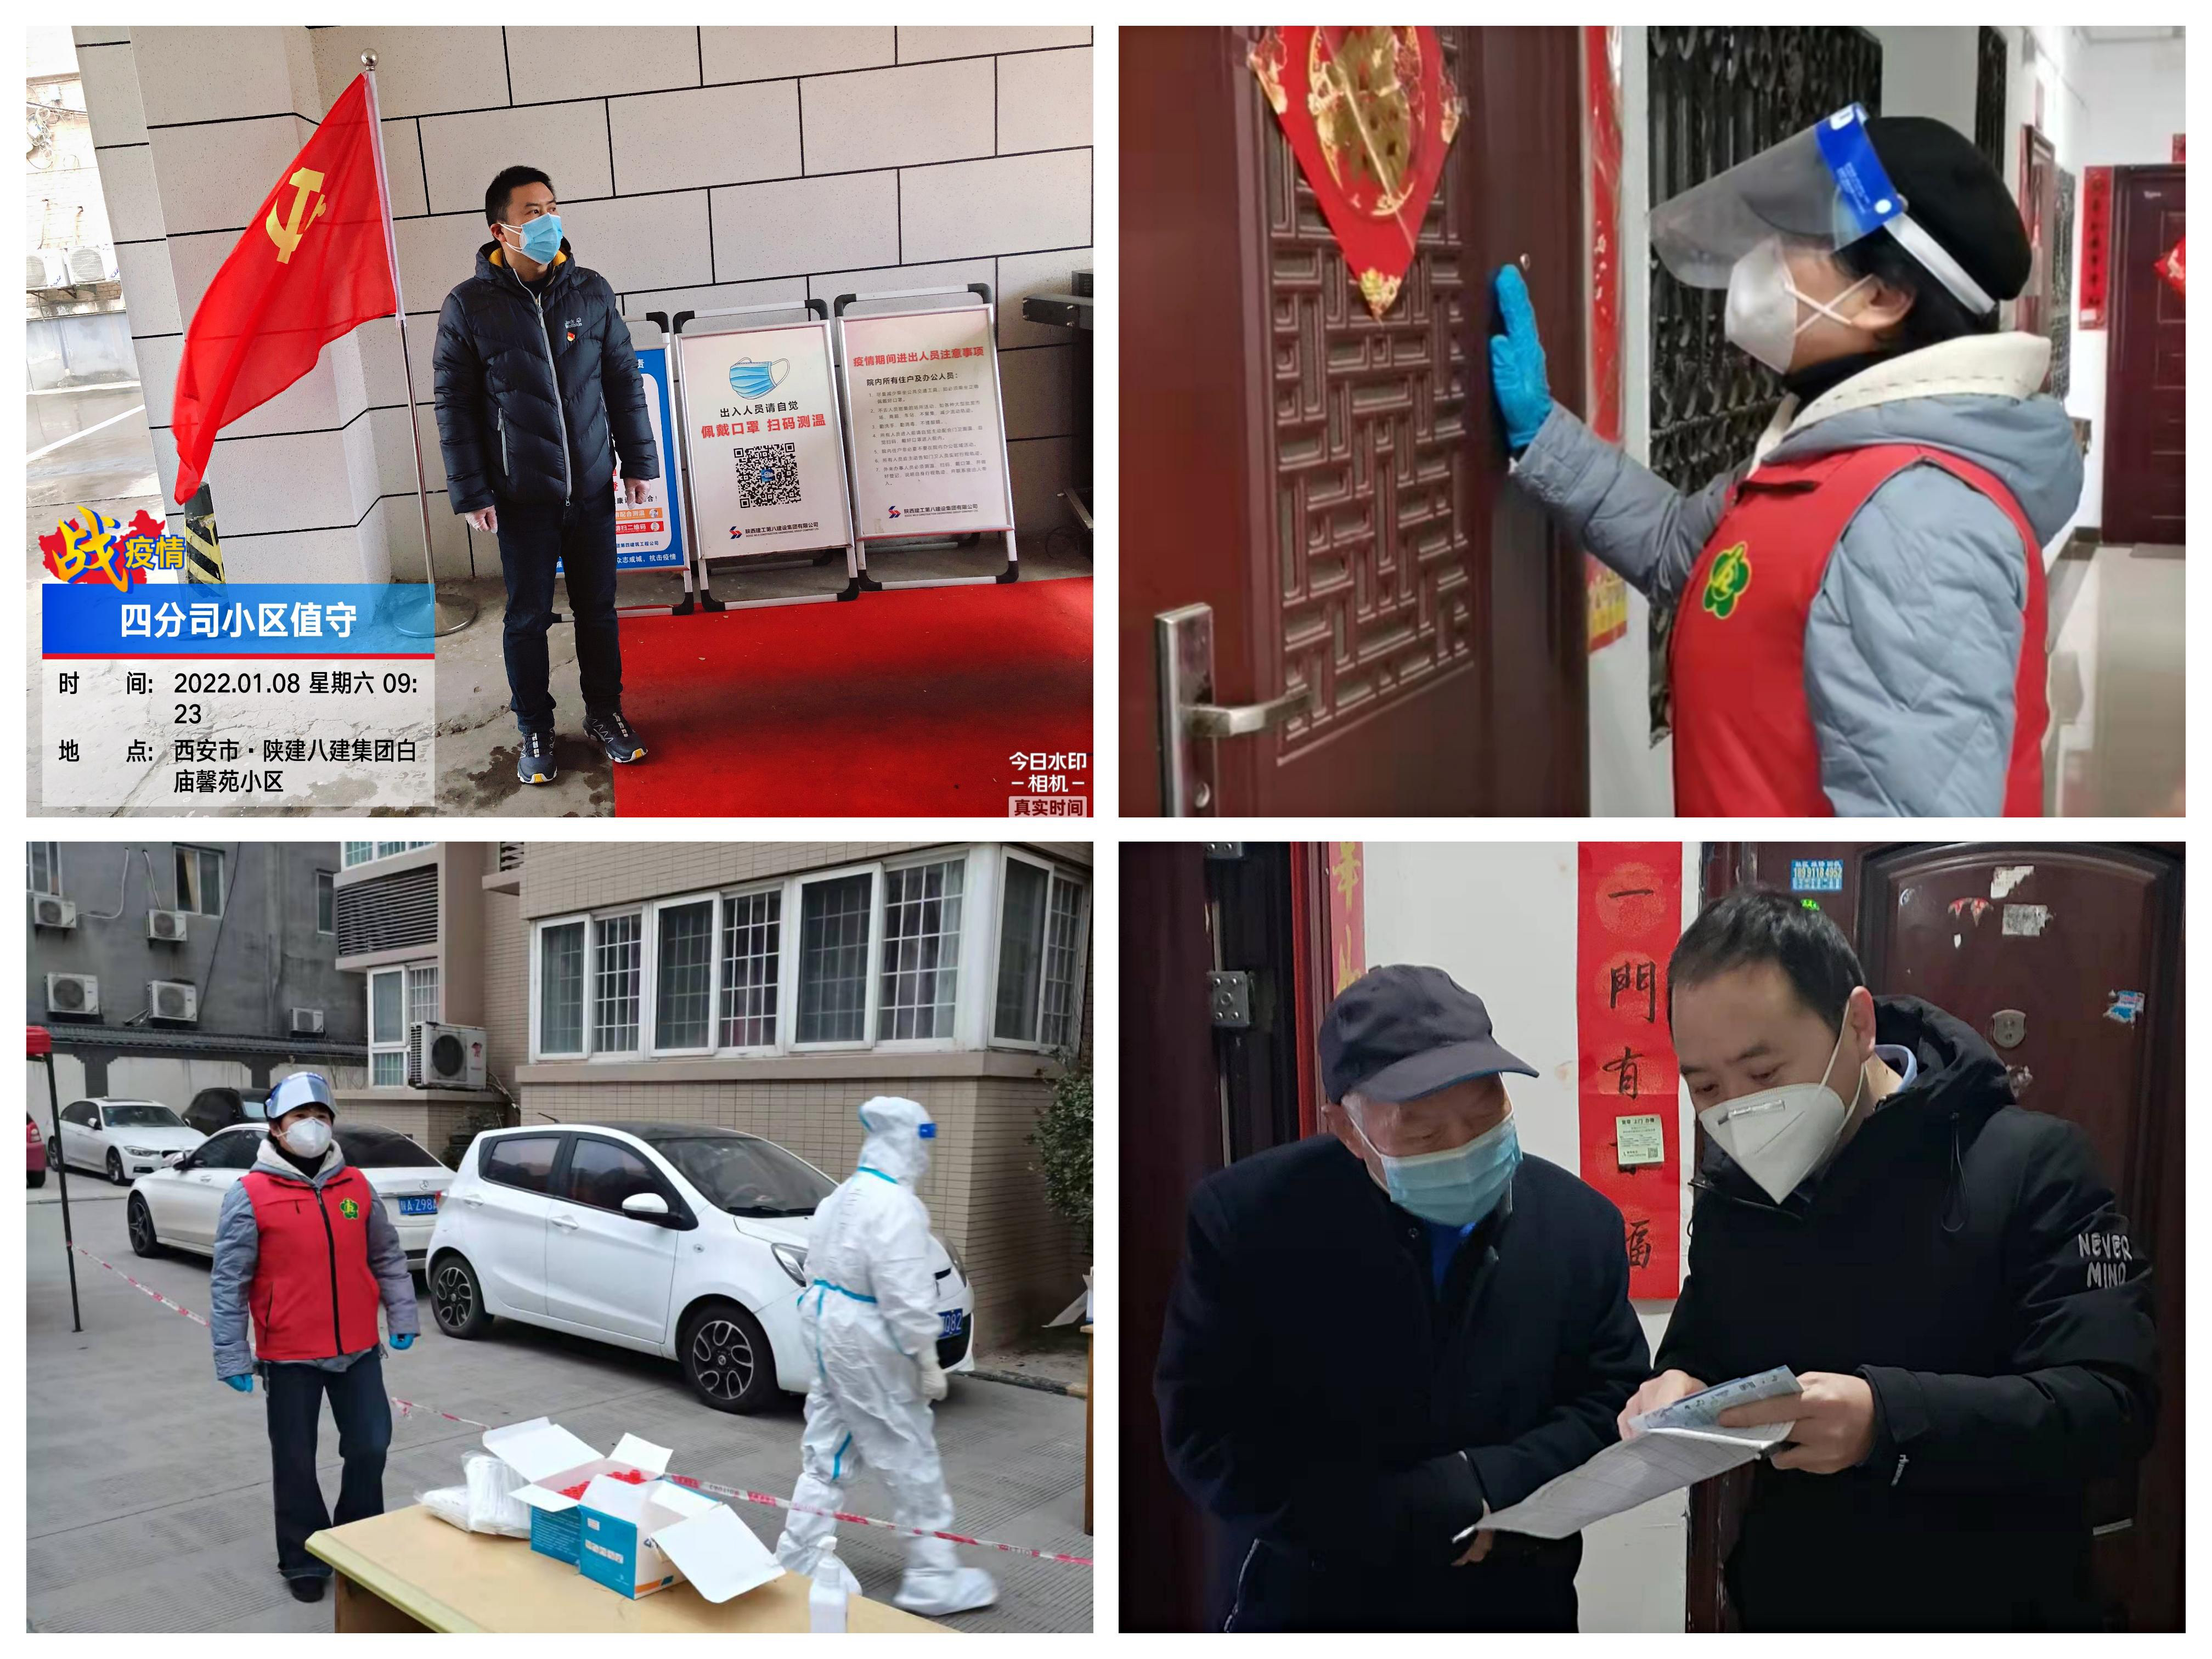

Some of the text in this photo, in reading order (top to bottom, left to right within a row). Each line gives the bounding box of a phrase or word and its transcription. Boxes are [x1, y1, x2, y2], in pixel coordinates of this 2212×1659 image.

[853, 346, 984, 367] 疫情期间进出人员注意事项
[720, 400, 799, 417] 出入人员请自觉
[701, 414, 826, 439] 佩戴口罩 扫码测温
[904, 503, 978, 514] 陕西建工第八建设集团有限公司
[745, 522, 819, 534] 陕西建工第八建设集团有限公司
[2078, 1232, 2133, 1261] NEVER
[2087, 1261, 2126, 1289] MIND
